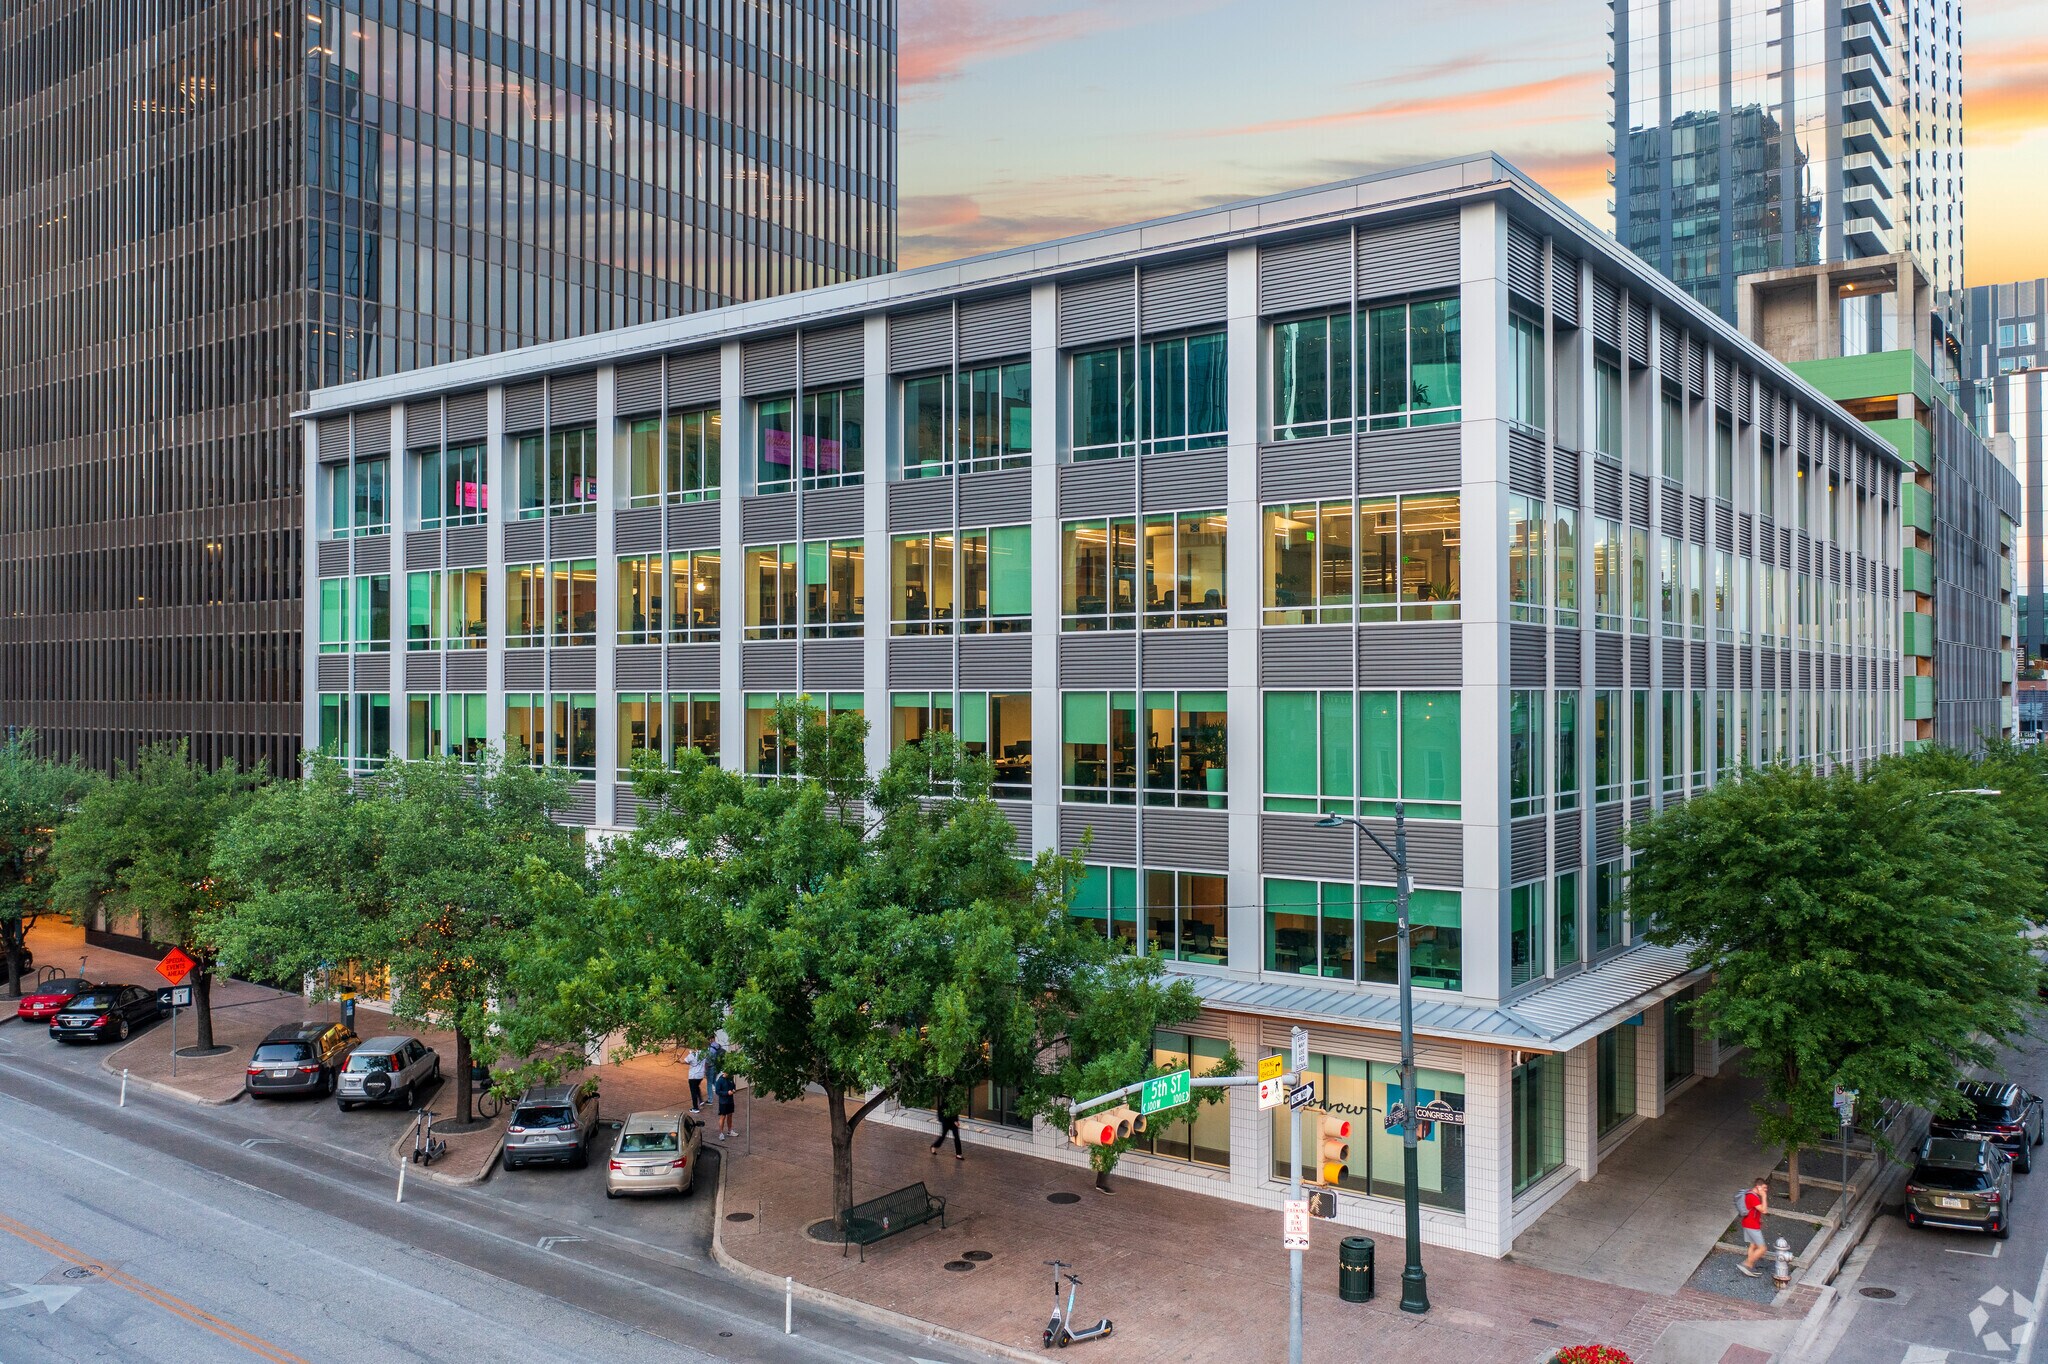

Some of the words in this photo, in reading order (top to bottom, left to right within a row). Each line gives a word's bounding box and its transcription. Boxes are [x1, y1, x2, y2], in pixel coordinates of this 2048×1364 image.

[166, 963, 186, 971] EVENTS
[179, 994, 182, 1003] 1
[1151, 1079, 1167, 1100] 5th
[1170, 1074, 1182, 1094] ST
[1417, 1110, 1454, 1121] CONGRESS
